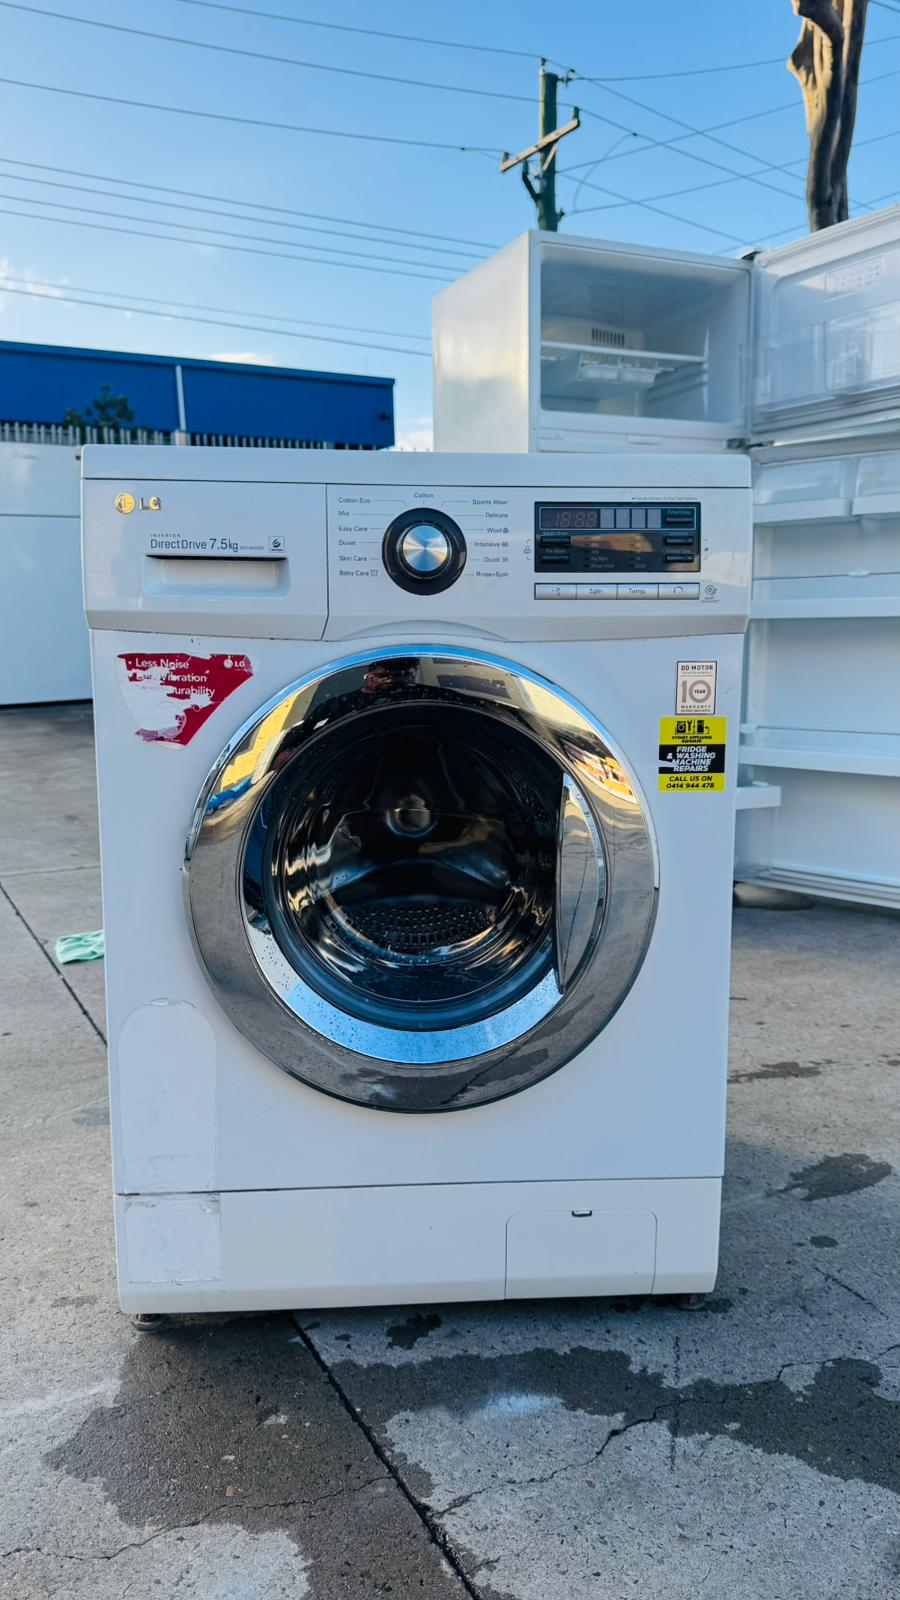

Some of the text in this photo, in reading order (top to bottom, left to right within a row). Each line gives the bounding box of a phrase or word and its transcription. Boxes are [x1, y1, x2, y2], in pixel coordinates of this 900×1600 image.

[139, 496, 162, 510] LG
[472, 498, 492, 506] Sports
[135, 658, 190, 669] Less Noise
[173, 686, 215, 698] urability
[681, 680, 712, 704] 10
[666, 752, 673, 760] &
[672, 758, 712, 766] MACHINE
